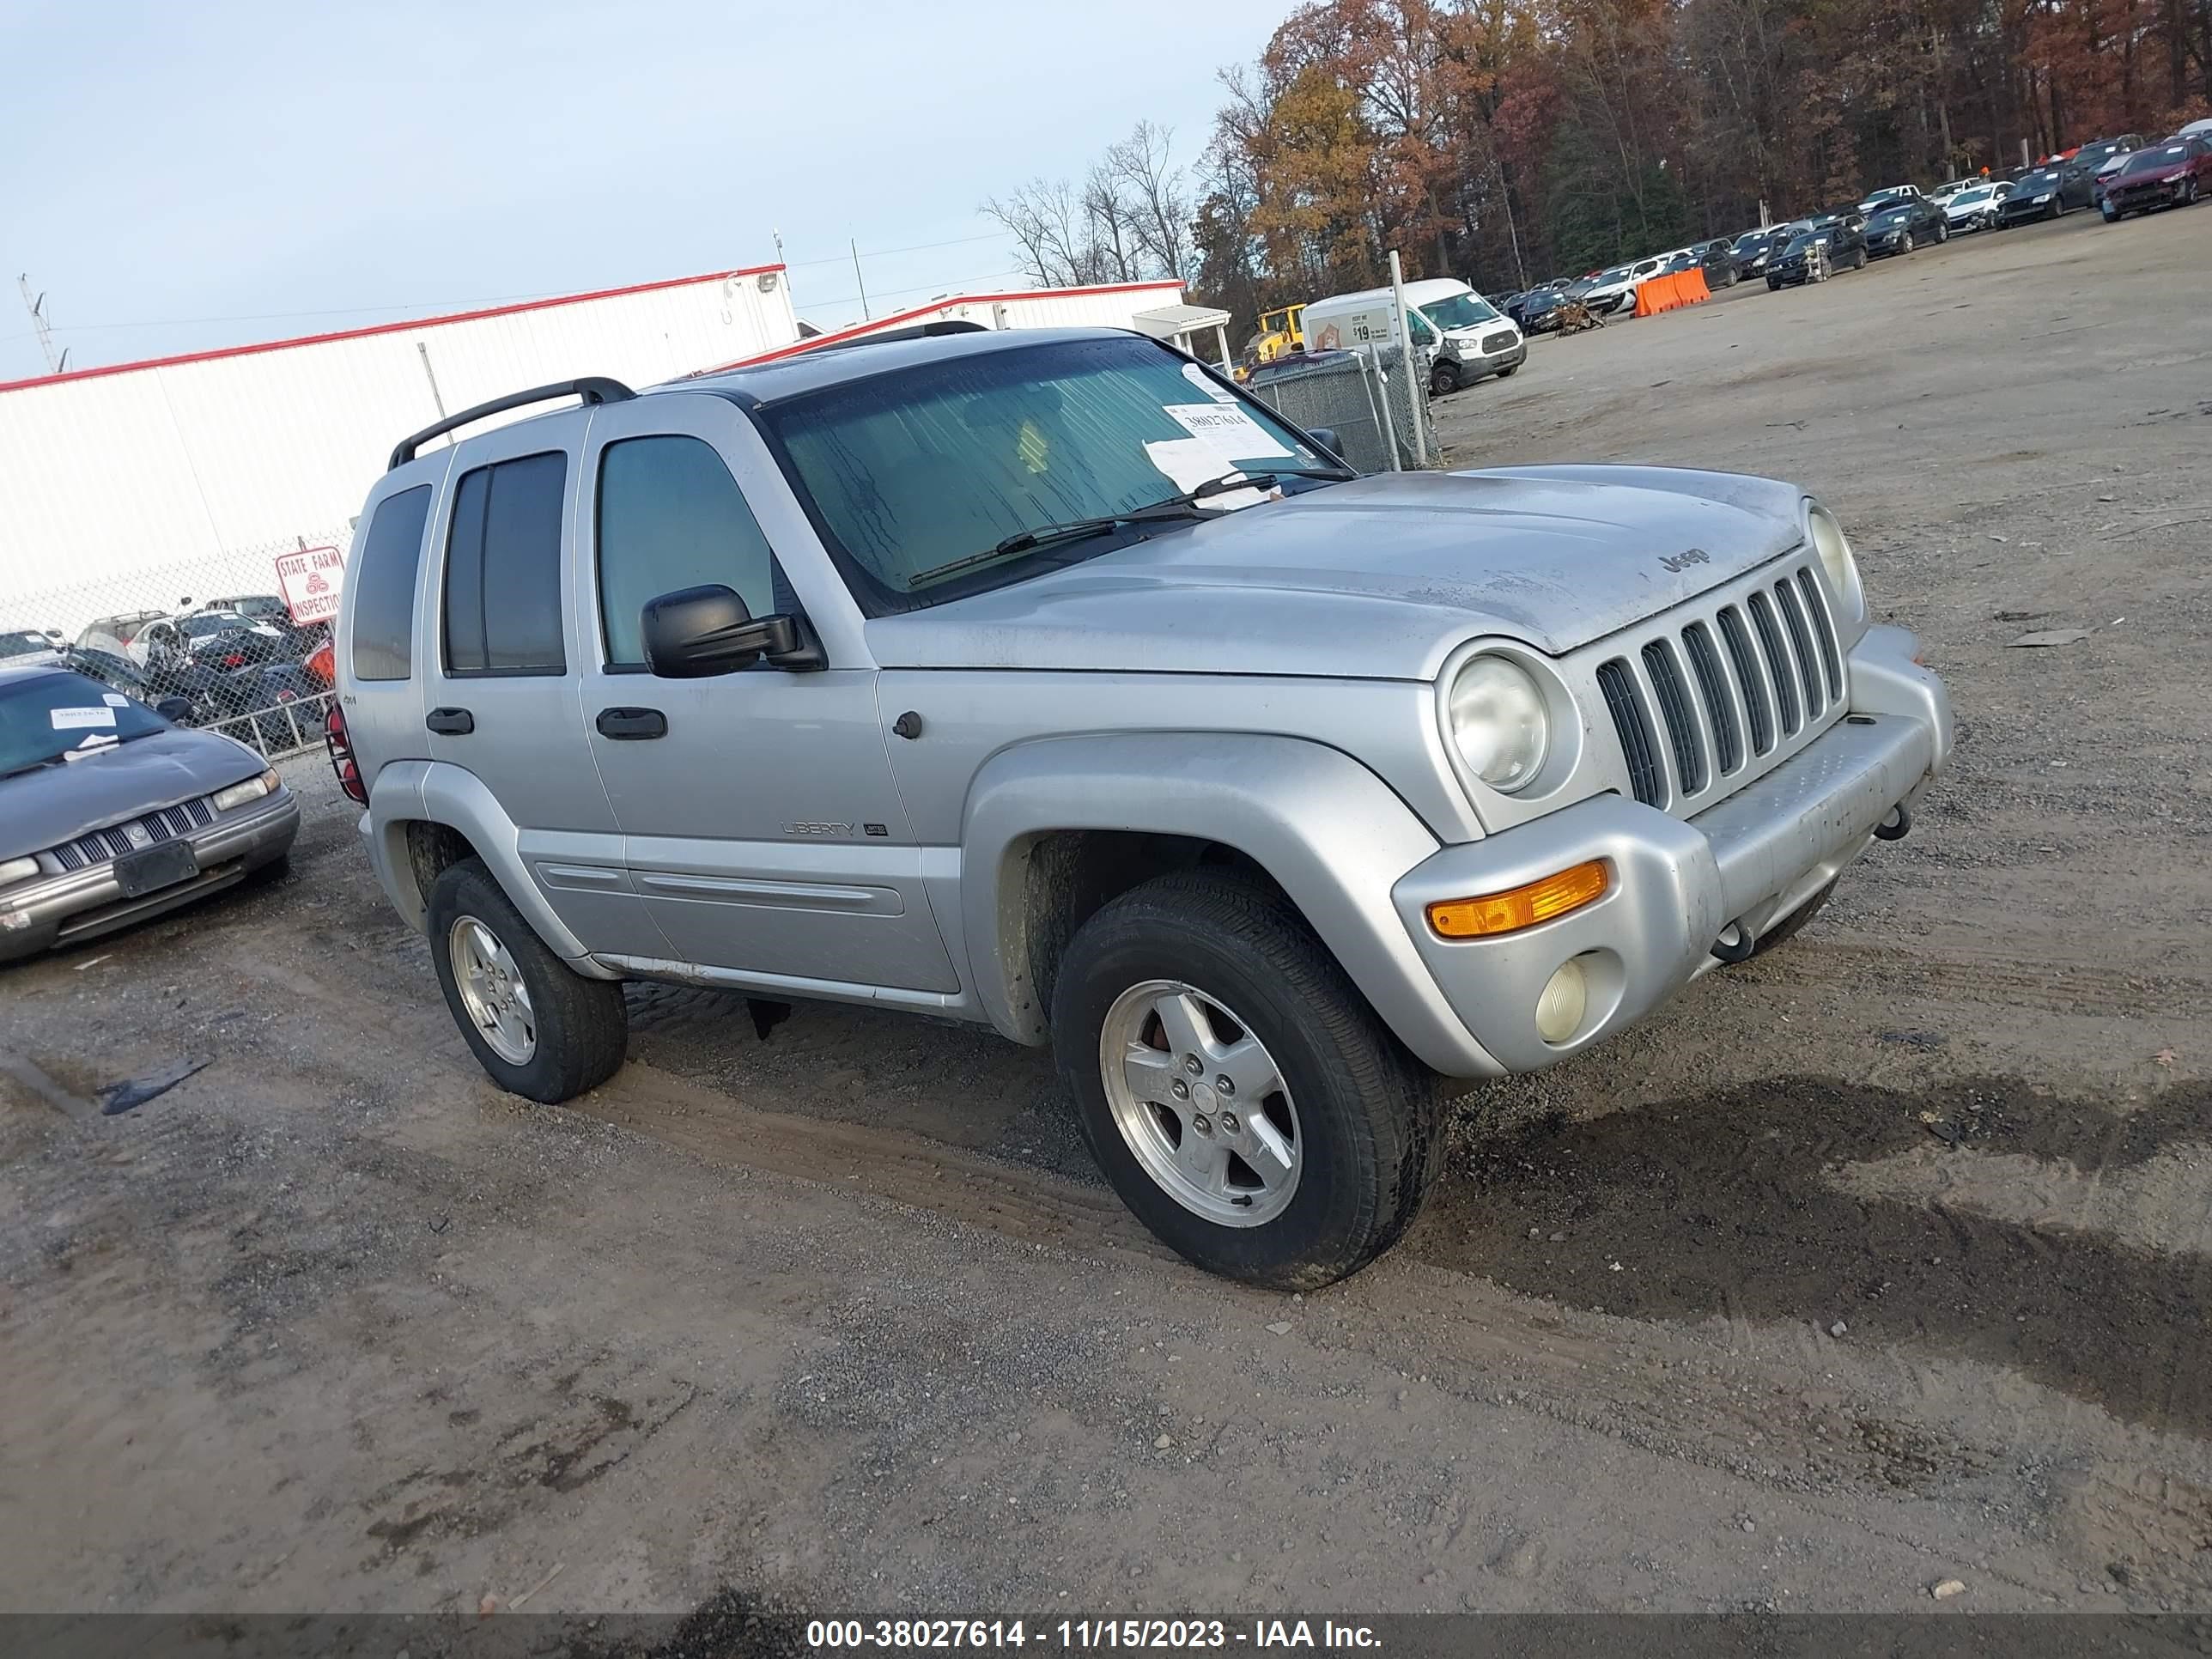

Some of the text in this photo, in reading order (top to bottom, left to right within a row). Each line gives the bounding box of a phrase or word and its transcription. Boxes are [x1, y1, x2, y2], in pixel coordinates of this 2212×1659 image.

[1353, 325, 1370, 341] $19
[1184, 415, 1248, 428] 38027614
[280, 552, 339, 577] STATE FARM
[1657, 549, 1710, 573] Jeep
[293, 592, 340, 618] INSPECTIO
[781, 821, 855, 837] LIBERTY
